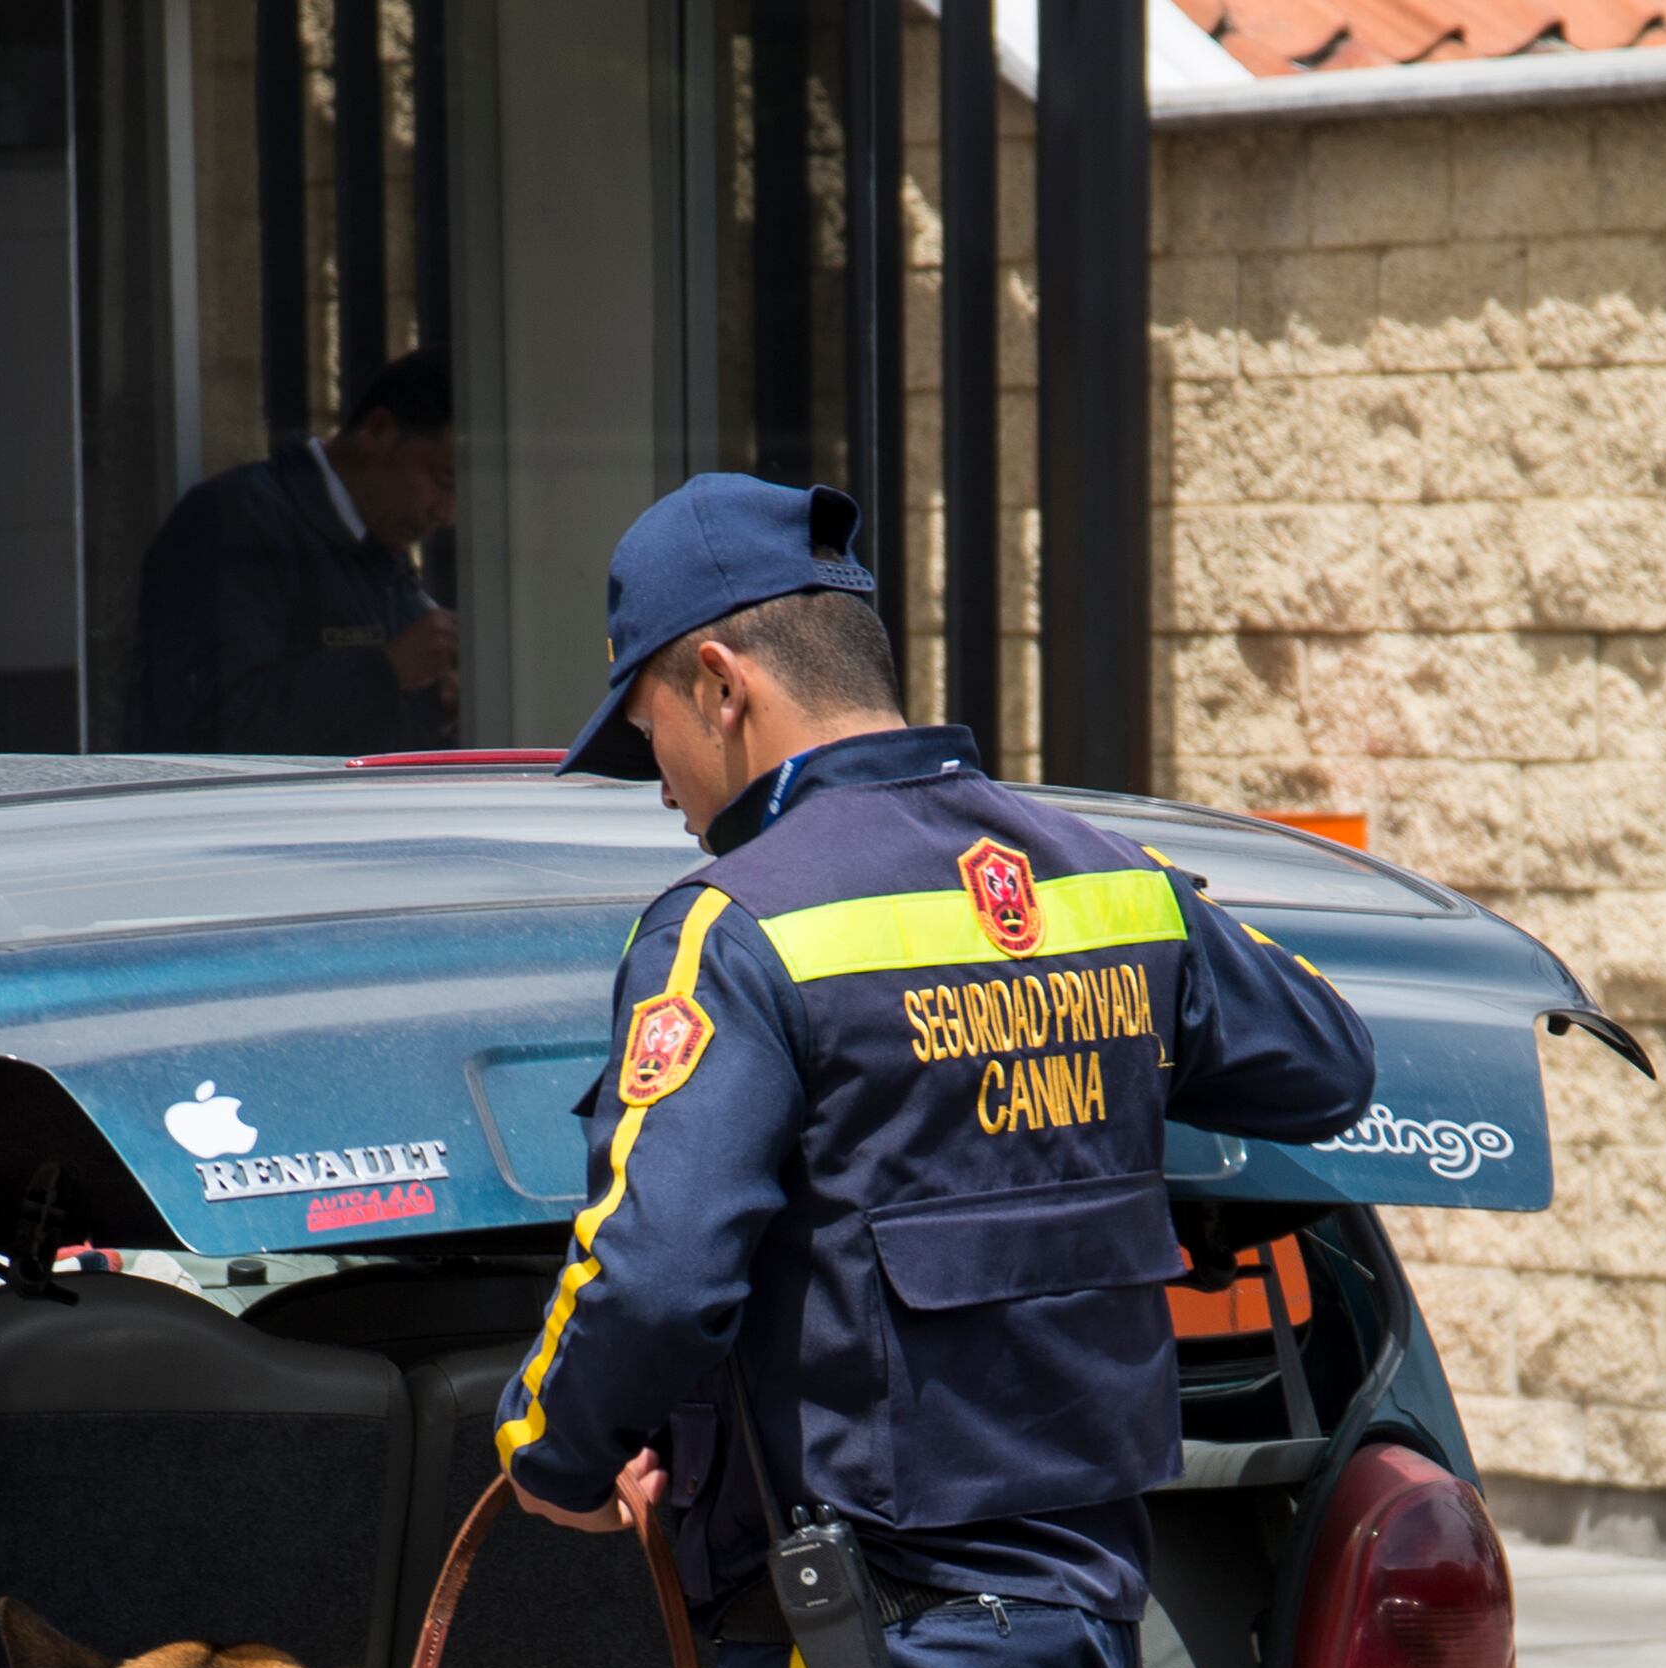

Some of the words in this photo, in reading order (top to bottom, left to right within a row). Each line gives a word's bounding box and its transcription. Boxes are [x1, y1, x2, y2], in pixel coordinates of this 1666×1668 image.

[904, 975, 1048, 1063] SEGURIDAD
[1047, 963, 1153, 1043] PRIVADA
[978, 1051, 1106, 1135] CANINA
[195, 1140, 450, 1202] RENAULT
[1308, 1103, 1515, 1179] wingo
